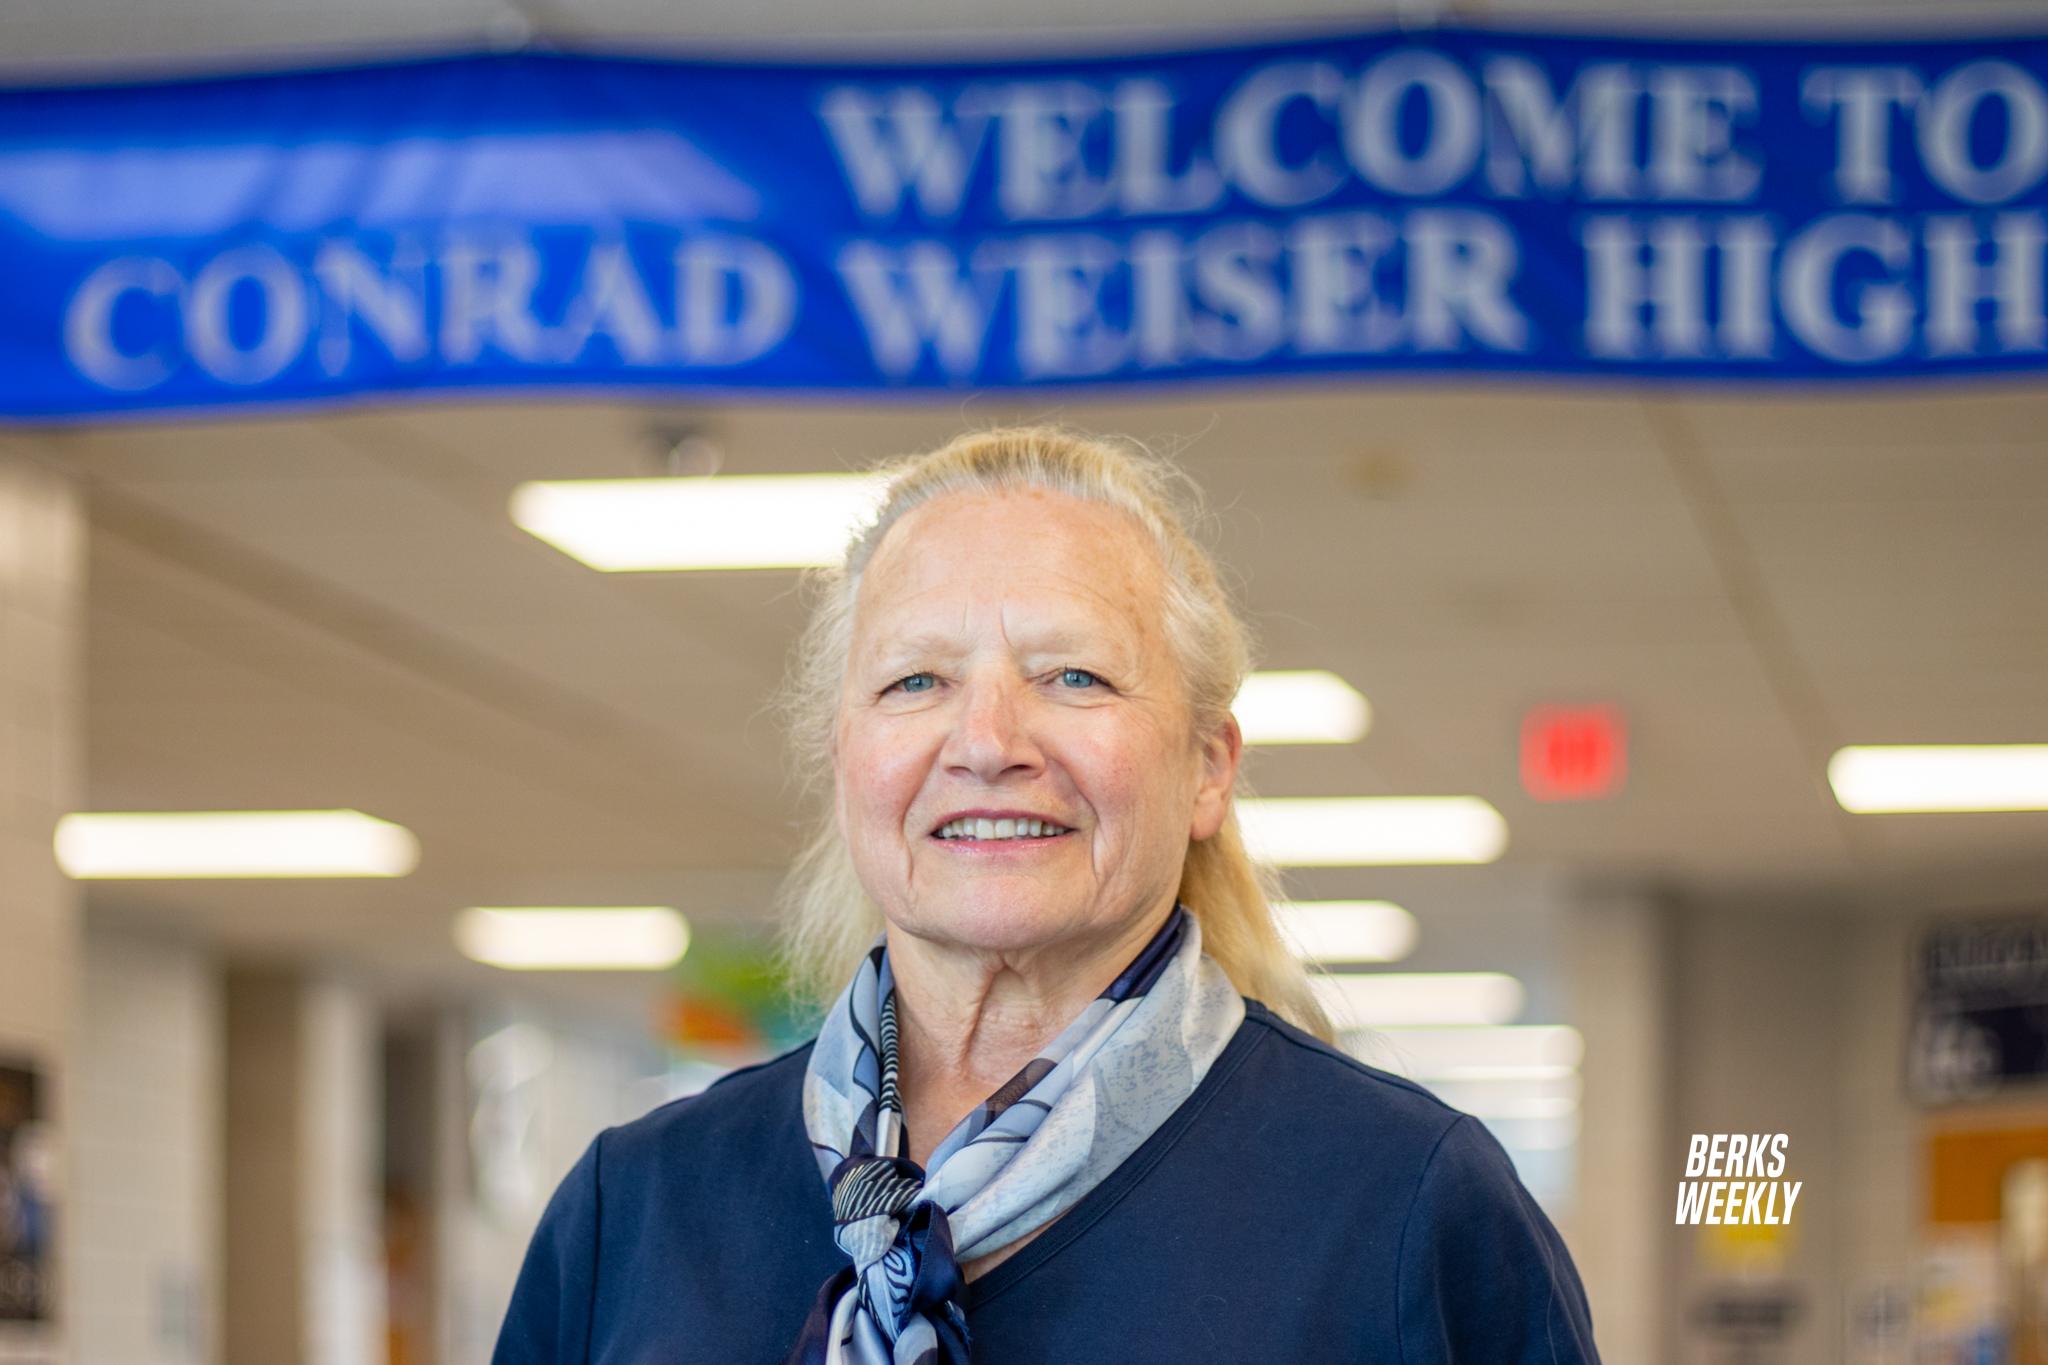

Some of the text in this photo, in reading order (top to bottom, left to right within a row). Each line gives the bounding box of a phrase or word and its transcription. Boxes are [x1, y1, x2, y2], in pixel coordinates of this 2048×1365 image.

[820, 50, 2048, 222] WELCOME TO
[64, 206, 2048, 390] CONRAD WEISER HIGH
